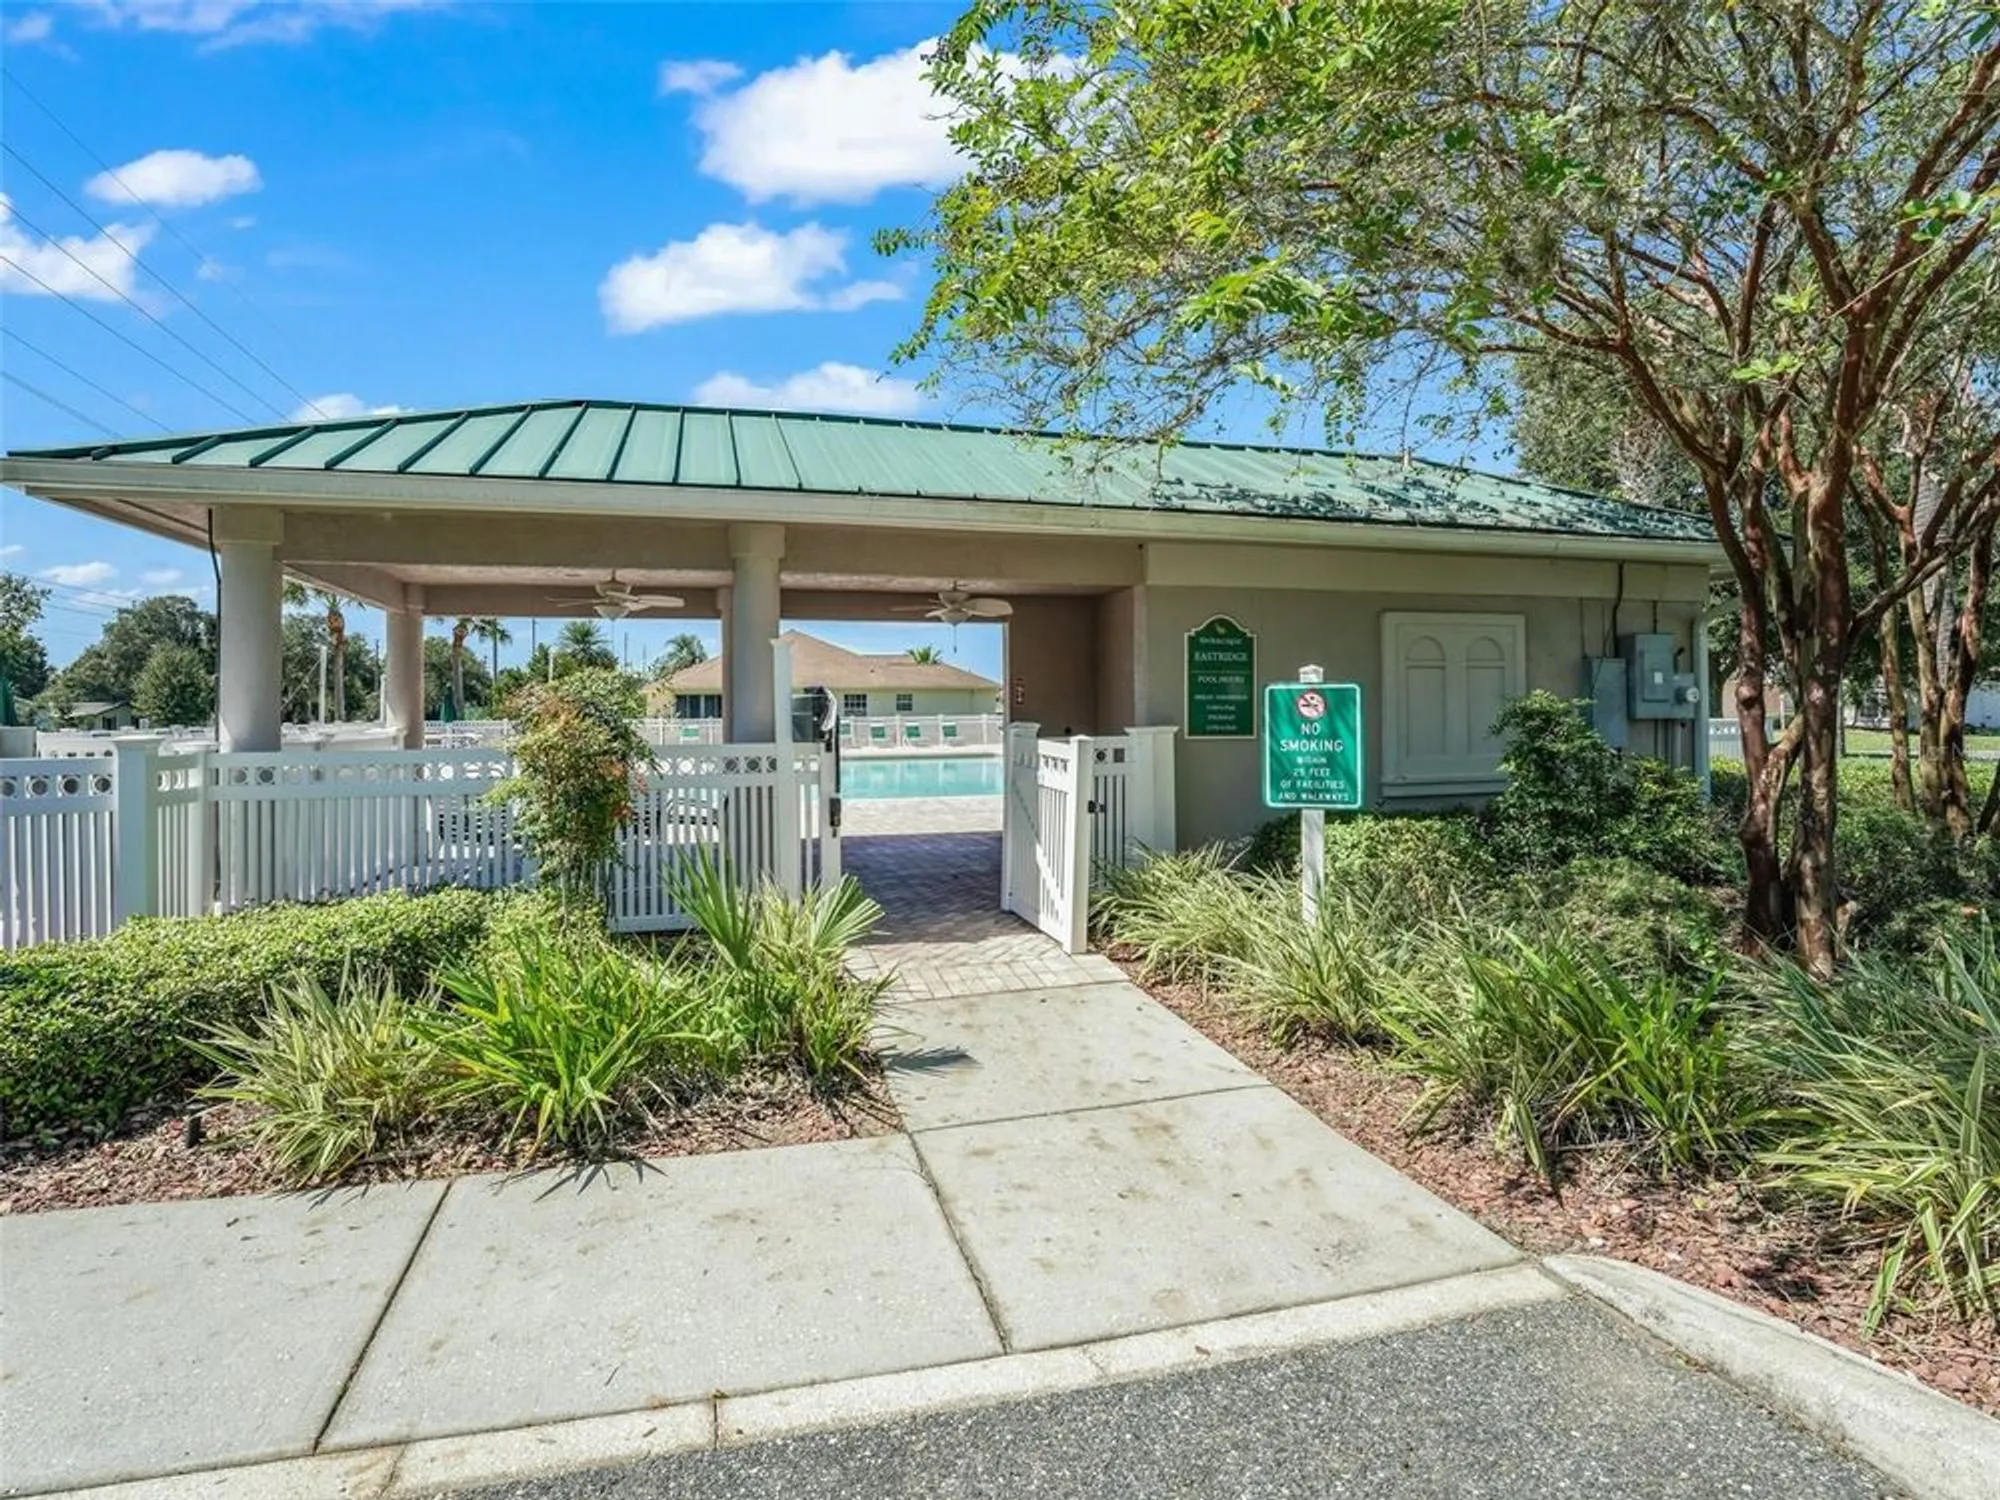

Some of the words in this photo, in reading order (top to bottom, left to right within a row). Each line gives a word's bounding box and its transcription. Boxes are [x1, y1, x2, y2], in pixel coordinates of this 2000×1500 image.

[1301, 722, 1321, 735] NO
[1280, 740, 1344, 752] SMOKING
[1296, 780, 1345, 789] FACILITIES
[1279, 792, 1296, 801] AND
